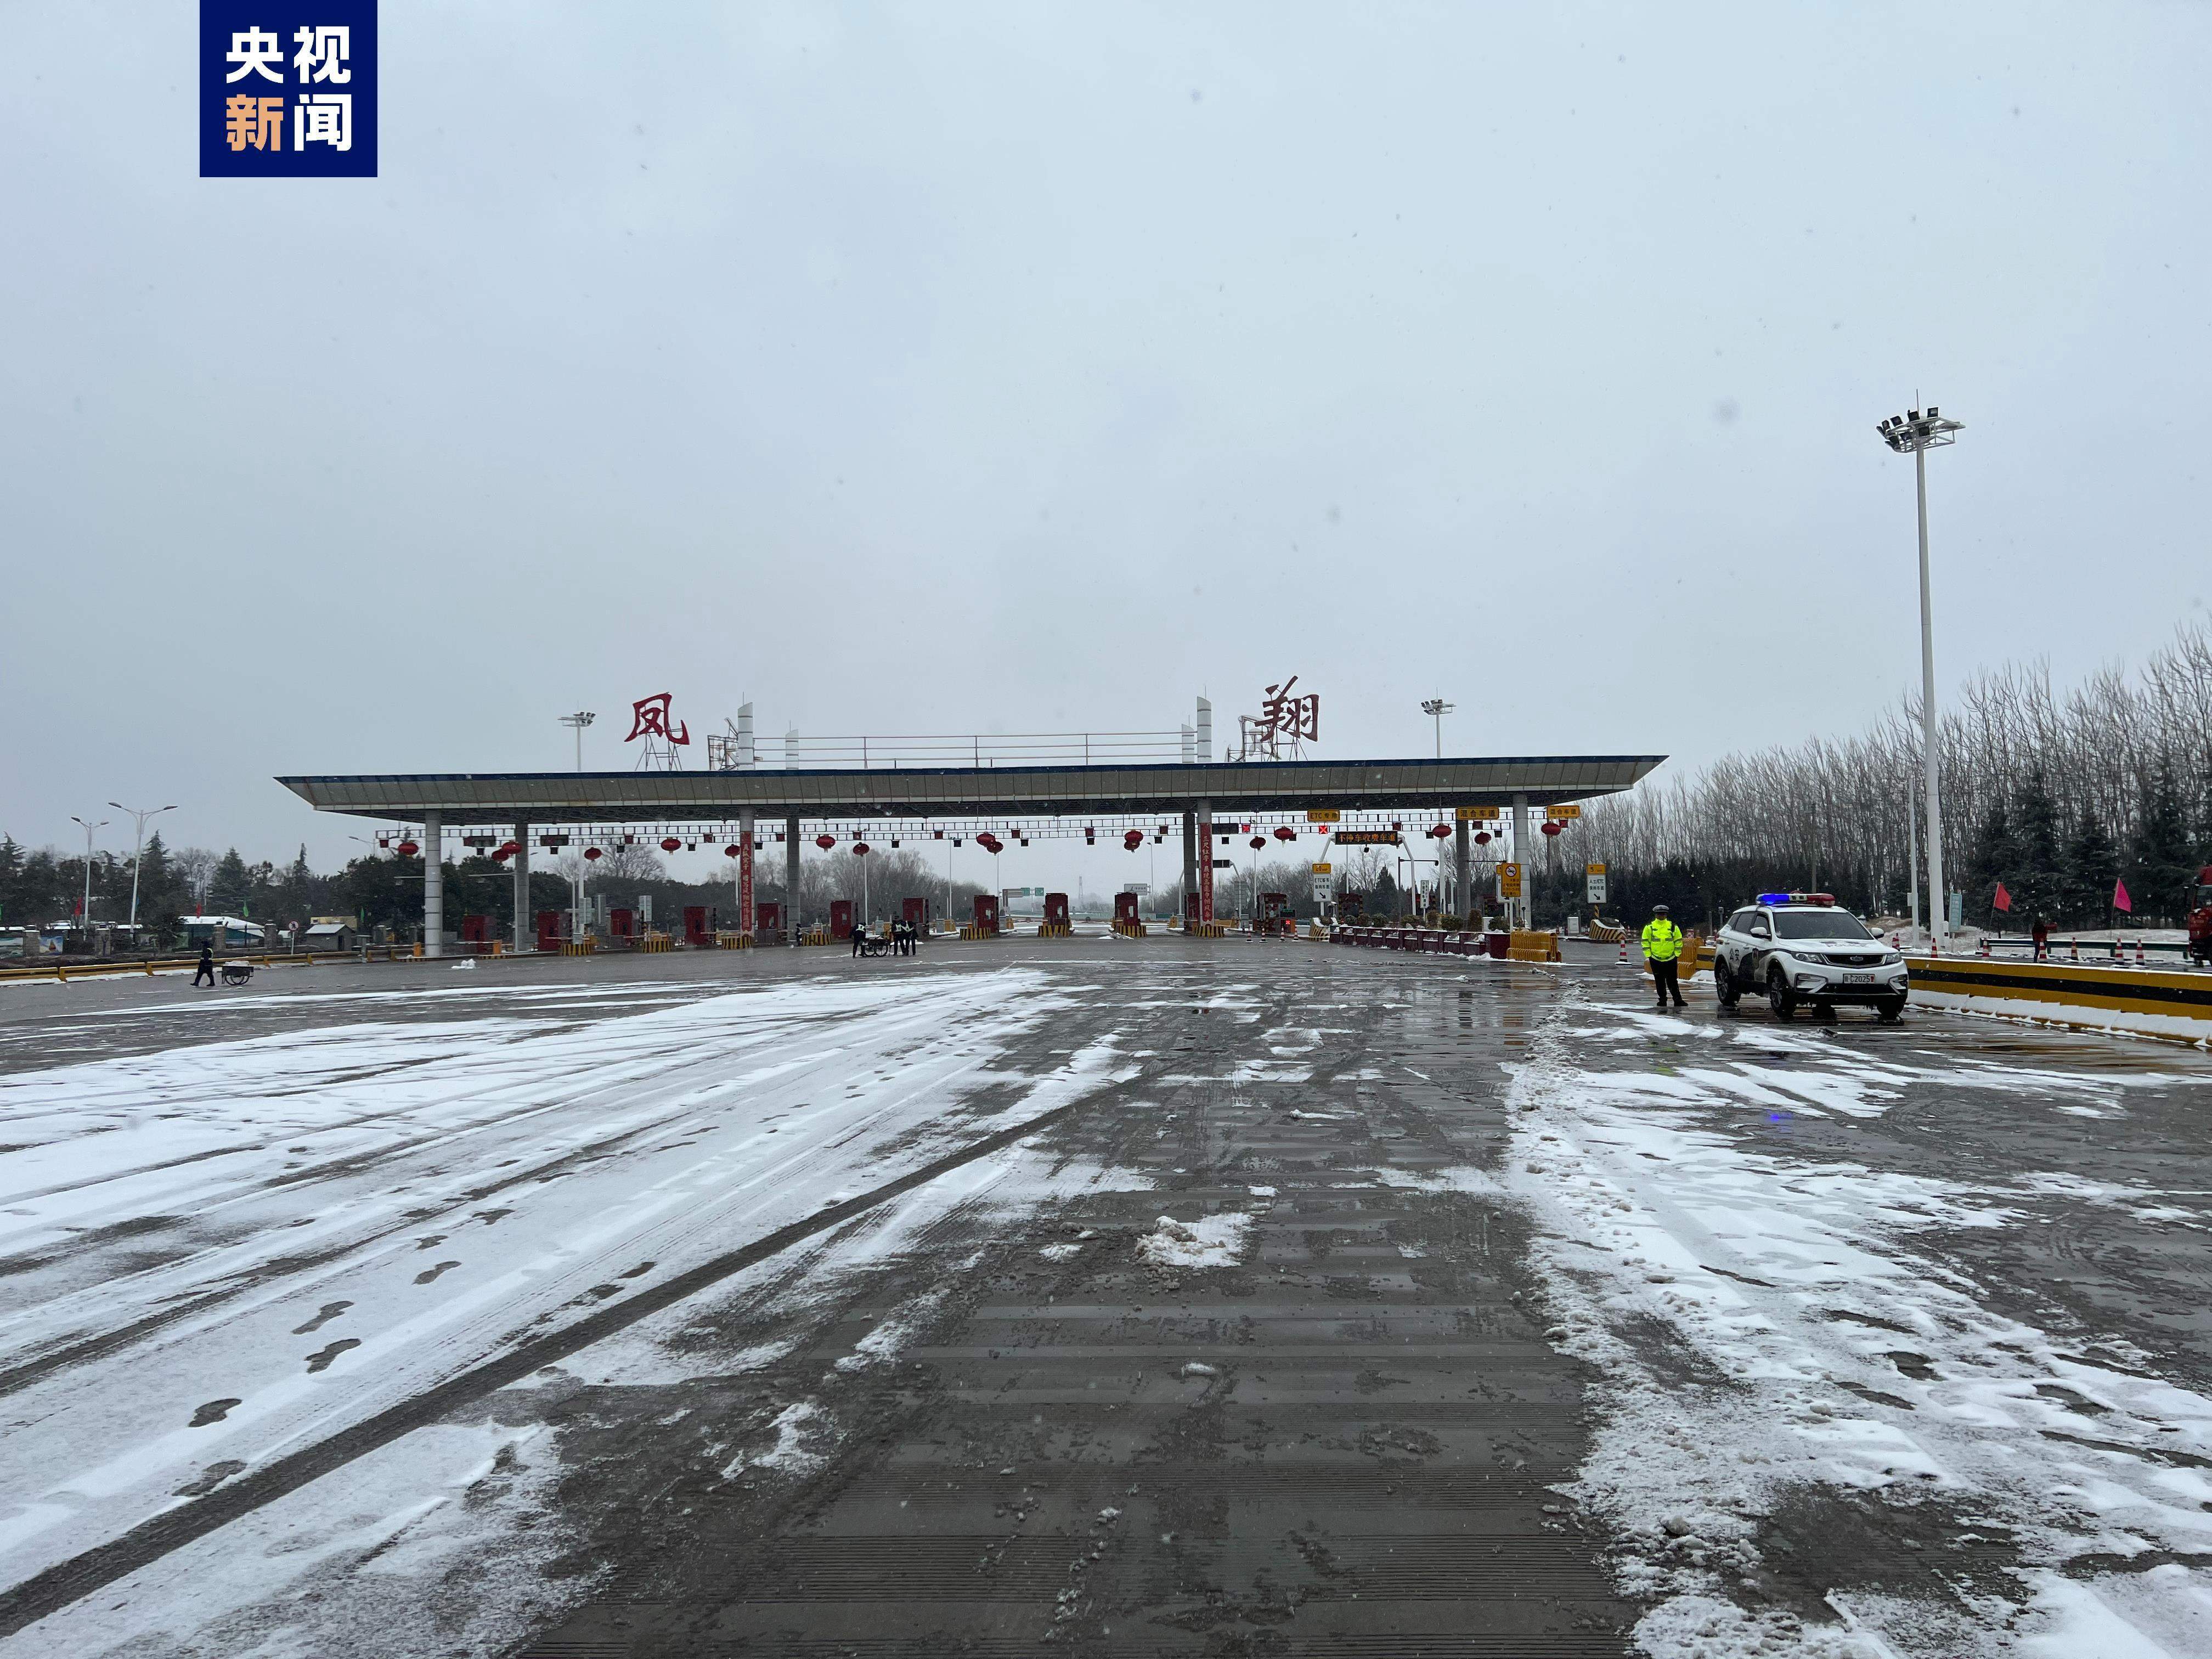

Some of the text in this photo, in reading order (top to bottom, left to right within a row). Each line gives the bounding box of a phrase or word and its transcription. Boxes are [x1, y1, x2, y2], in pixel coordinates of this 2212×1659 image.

[624, 675, 1319, 745] 凤 翔
[1339, 834, 1395, 842] 不停车收费车道
[1729, 948, 1740, 961] 公安
